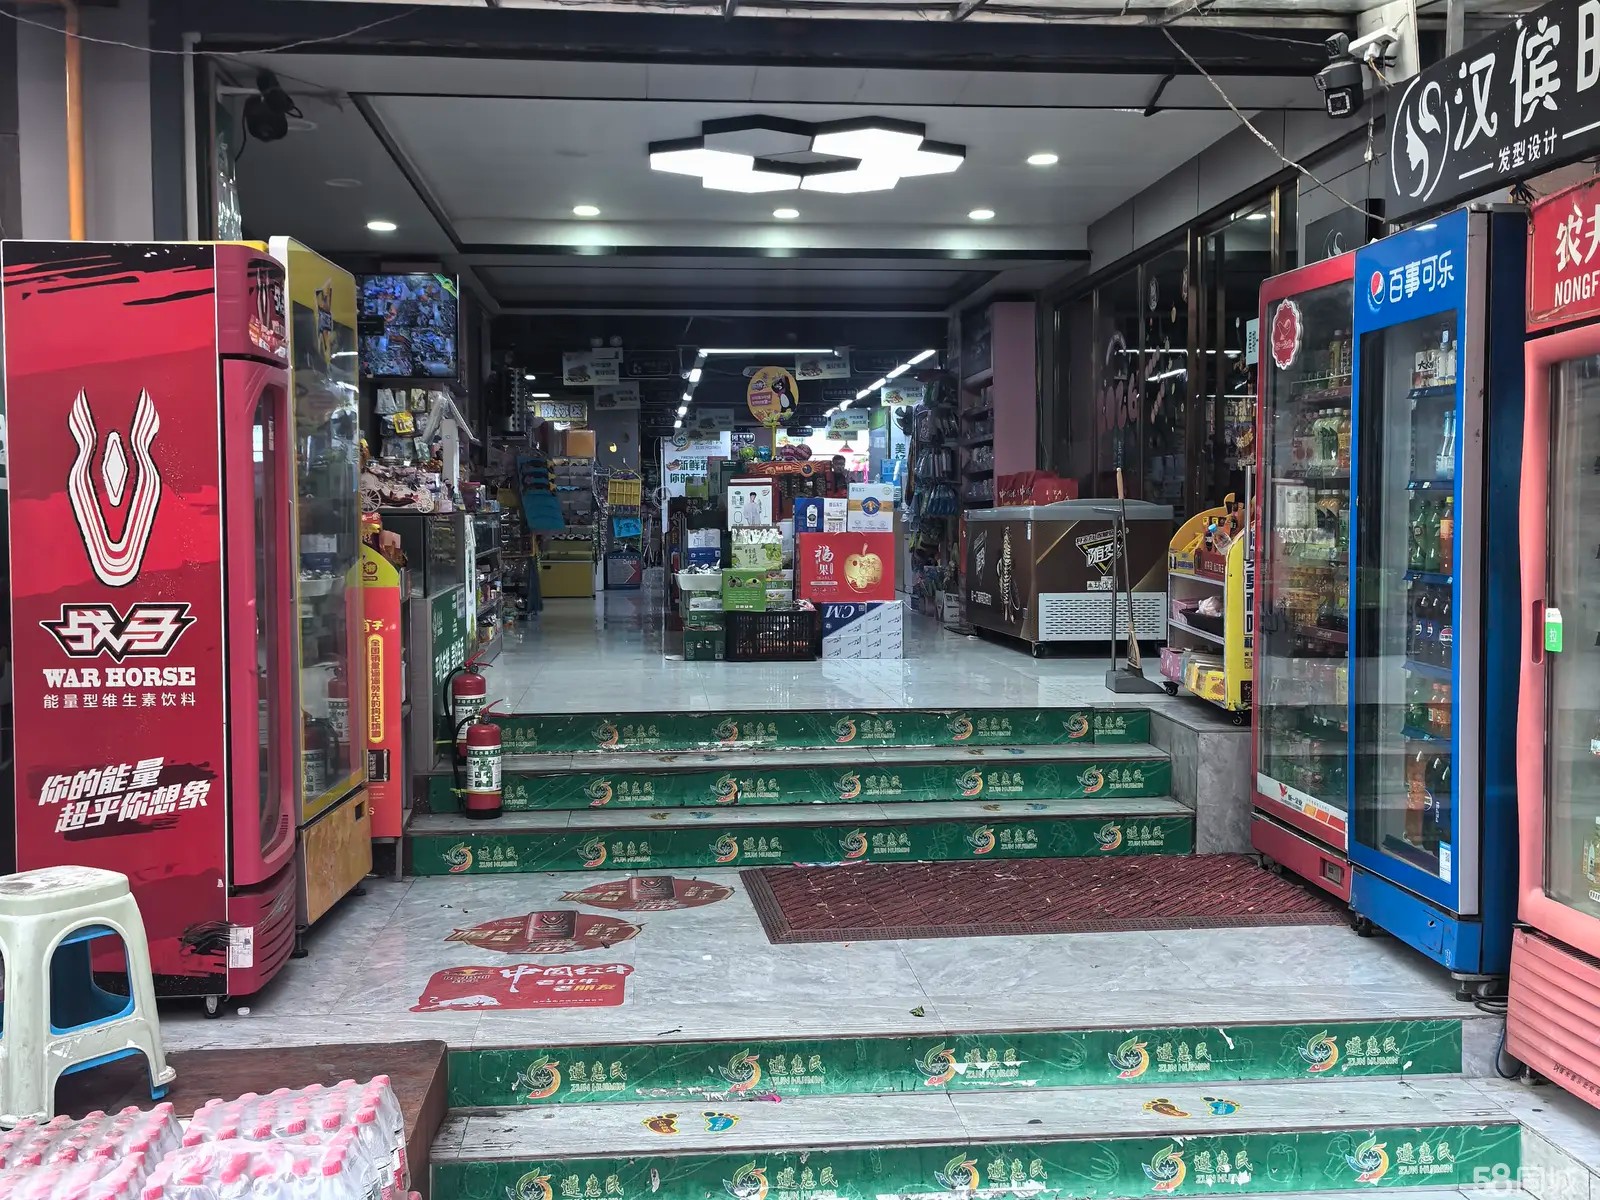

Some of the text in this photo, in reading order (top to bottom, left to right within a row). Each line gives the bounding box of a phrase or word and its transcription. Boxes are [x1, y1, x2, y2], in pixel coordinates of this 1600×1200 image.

[1497, 127, 1558, 174] 发型设计
[1388, 250, 1455, 304] 百事可乐
[824, 605, 855, 618] CM
[56, 606, 185, 656] 战马
[43, 667, 196, 688] WAR HORSE
[43, 692, 196, 709] 能量型维生素饮料
[38, 756, 165, 806] 你的能量
[55, 779, 211, 833] 超乎你想象
[1156, 1041, 1212, 1063] 遵惠民
[1346, 1035, 1400, 1057] 遵惠民
[569, 1060, 628, 1082] 遵惠民
[769, 1054, 827, 1076] 遵惠民
[1157, 1062, 1210, 1073] ZUN HUIMIN
[1347, 1056, 1399, 1067] ZUN HUIMIN
[768, 1075, 825, 1086] ZUN HUIMIN
[966, 1068, 1019, 1079] ZUN HUIMIN
[570, 1082, 626, 1093] ZUN HUIMIN
[1193, 1150, 1254, 1173] 遵惠民
[1396, 1142, 1455, 1165] 遵惠民
[777, 1166, 840, 1190] 遵惠民
[988, 1159, 1047, 1182] 遵惠民
[1398, 1164, 1453, 1175] ZUN HUIMIN
[561, 1174, 625, 1198] 遵惠民
